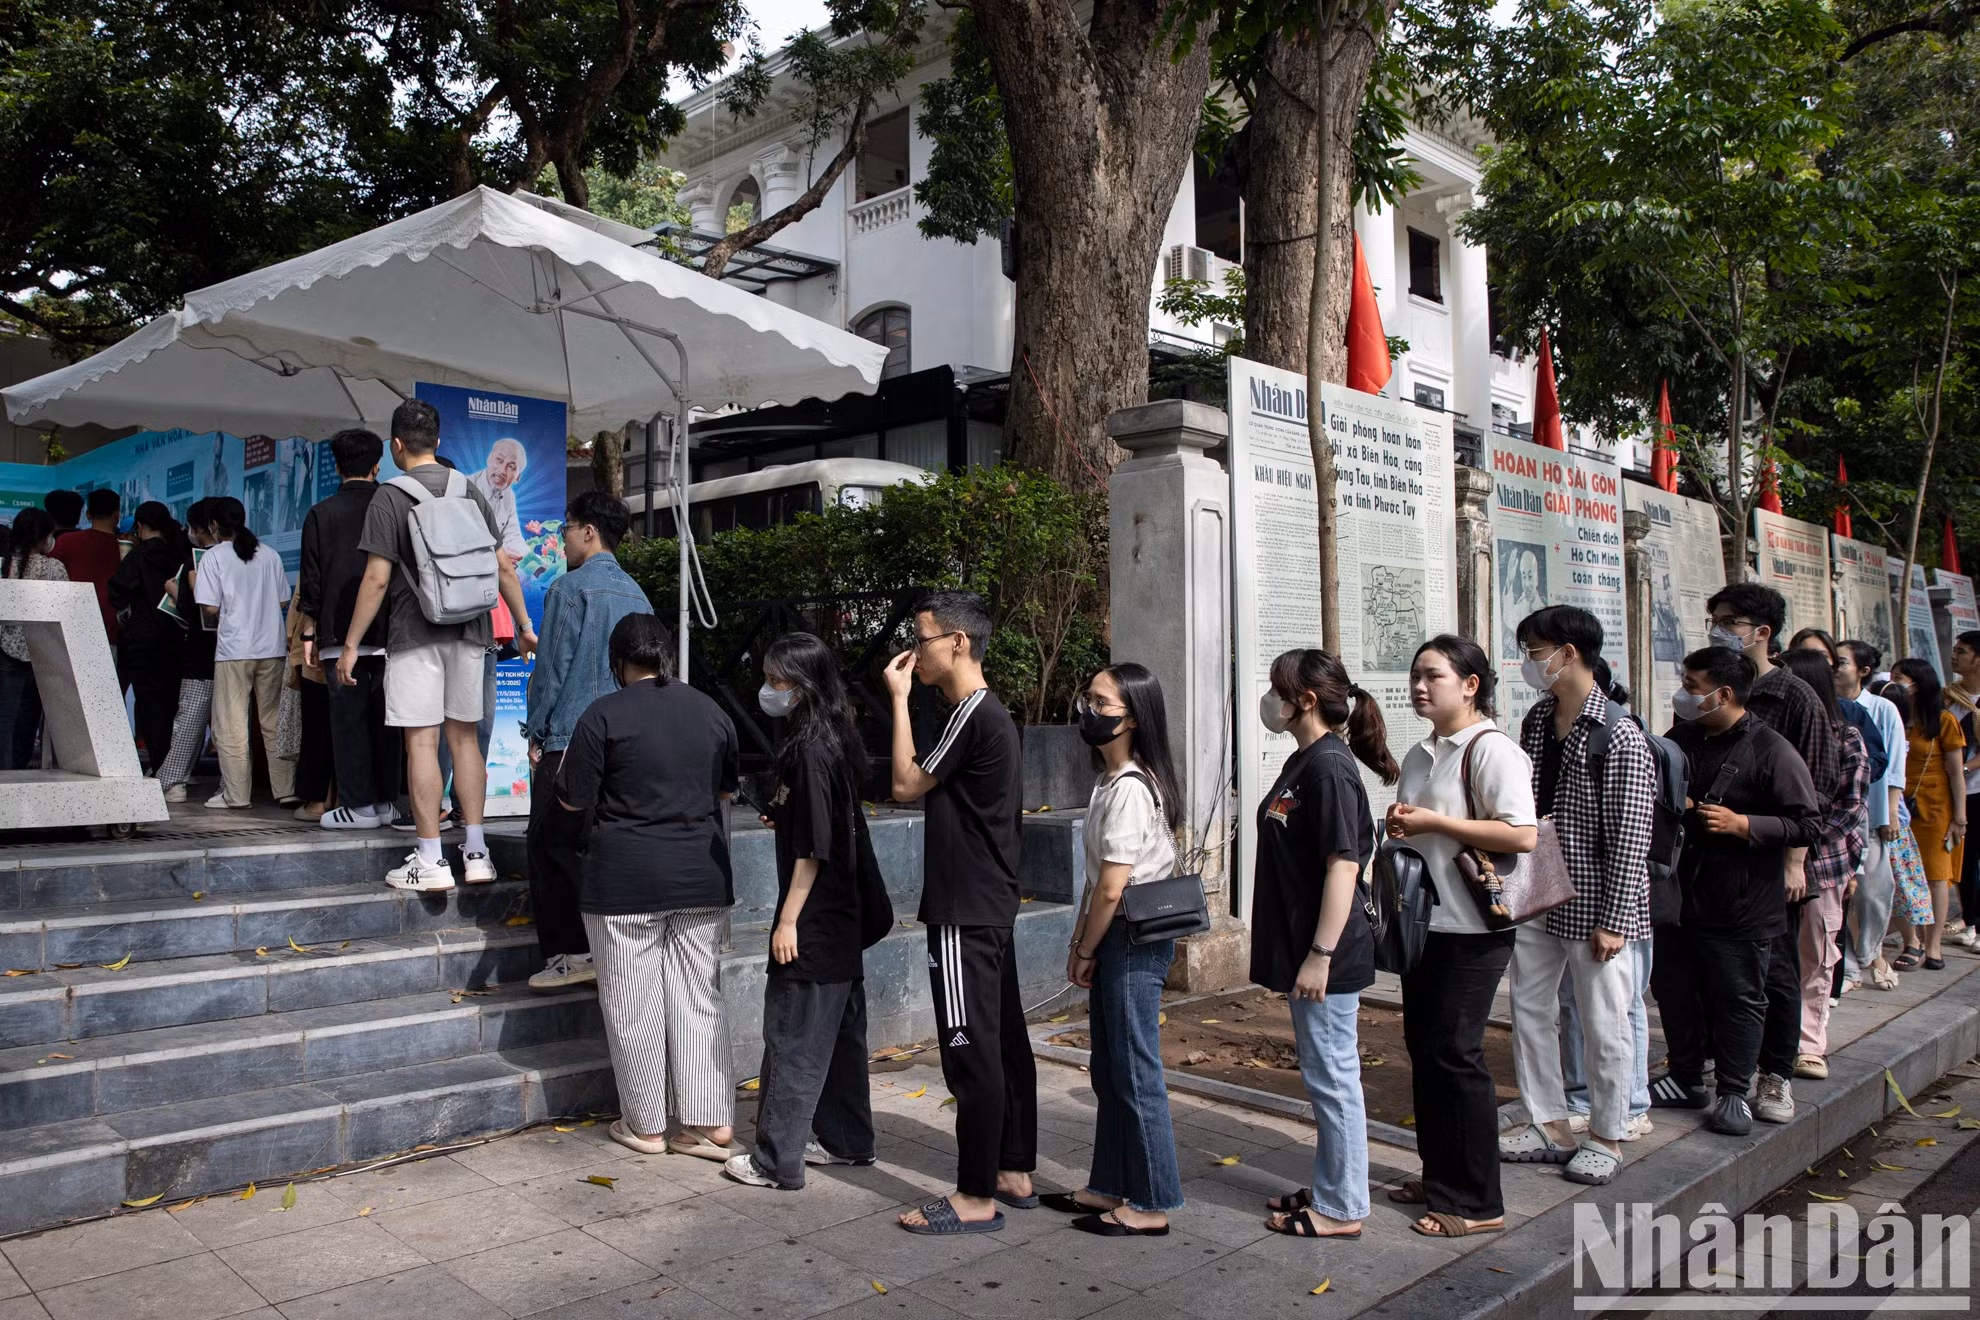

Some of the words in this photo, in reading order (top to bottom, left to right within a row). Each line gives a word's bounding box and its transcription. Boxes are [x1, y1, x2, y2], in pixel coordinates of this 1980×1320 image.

[468, 397, 497, 413] Nhân
[497, 400, 519, 416] Dân
[1250, 376, 1292, 417] Nhân
[1330, 413, 1347, 433] Giải
[1353, 420, 1377, 442] phóng
[1382, 426, 1401, 446] hoàn
[1405, 433, 1422, 450] toàn
[1347, 445, 1357, 459] xã
[1362, 445, 1379, 464] Biên
[1383, 450, 1400, 471] Hòa,
[1405, 456, 1422, 475] cảng
[1493, 449, 1537, 479] HOAN
[1542, 461, 1562, 485] HÔ
[1567, 465, 1586, 490] SÀI
[1591, 472, 1616, 496] GÒN
[1277, 468, 1292, 488] HIỆU
[1296, 472, 1311, 490] NGÀY
[1374, 472, 1388, 490] tỉnh
[1391, 475, 1406, 493] Biên
[1409, 479, 1422, 496] Hòa
[1343, 492, 1352, 506] và
[1356, 492, 1371, 510] tỉnh
[1375, 495, 1399, 514] Phước
[1403, 500, 1415, 521] Tuy
[1497, 483, 1522, 510] Nhân
[1524, 489, 1542, 514] Dân
[1544, 489, 1570, 515] GIẢI
[1575, 498, 1617, 524] PHÓNG
[1578, 527, 1601, 543] Chiến
[1603, 531, 1619, 546] dịch
[1571, 547, 1583, 562] Hồ
[1586, 550, 1599, 564] Chí
[1601, 552, 1619, 566] Minh
[1573, 570, 1592, 585] toàn
[1598, 572, 1621, 593] thắng
